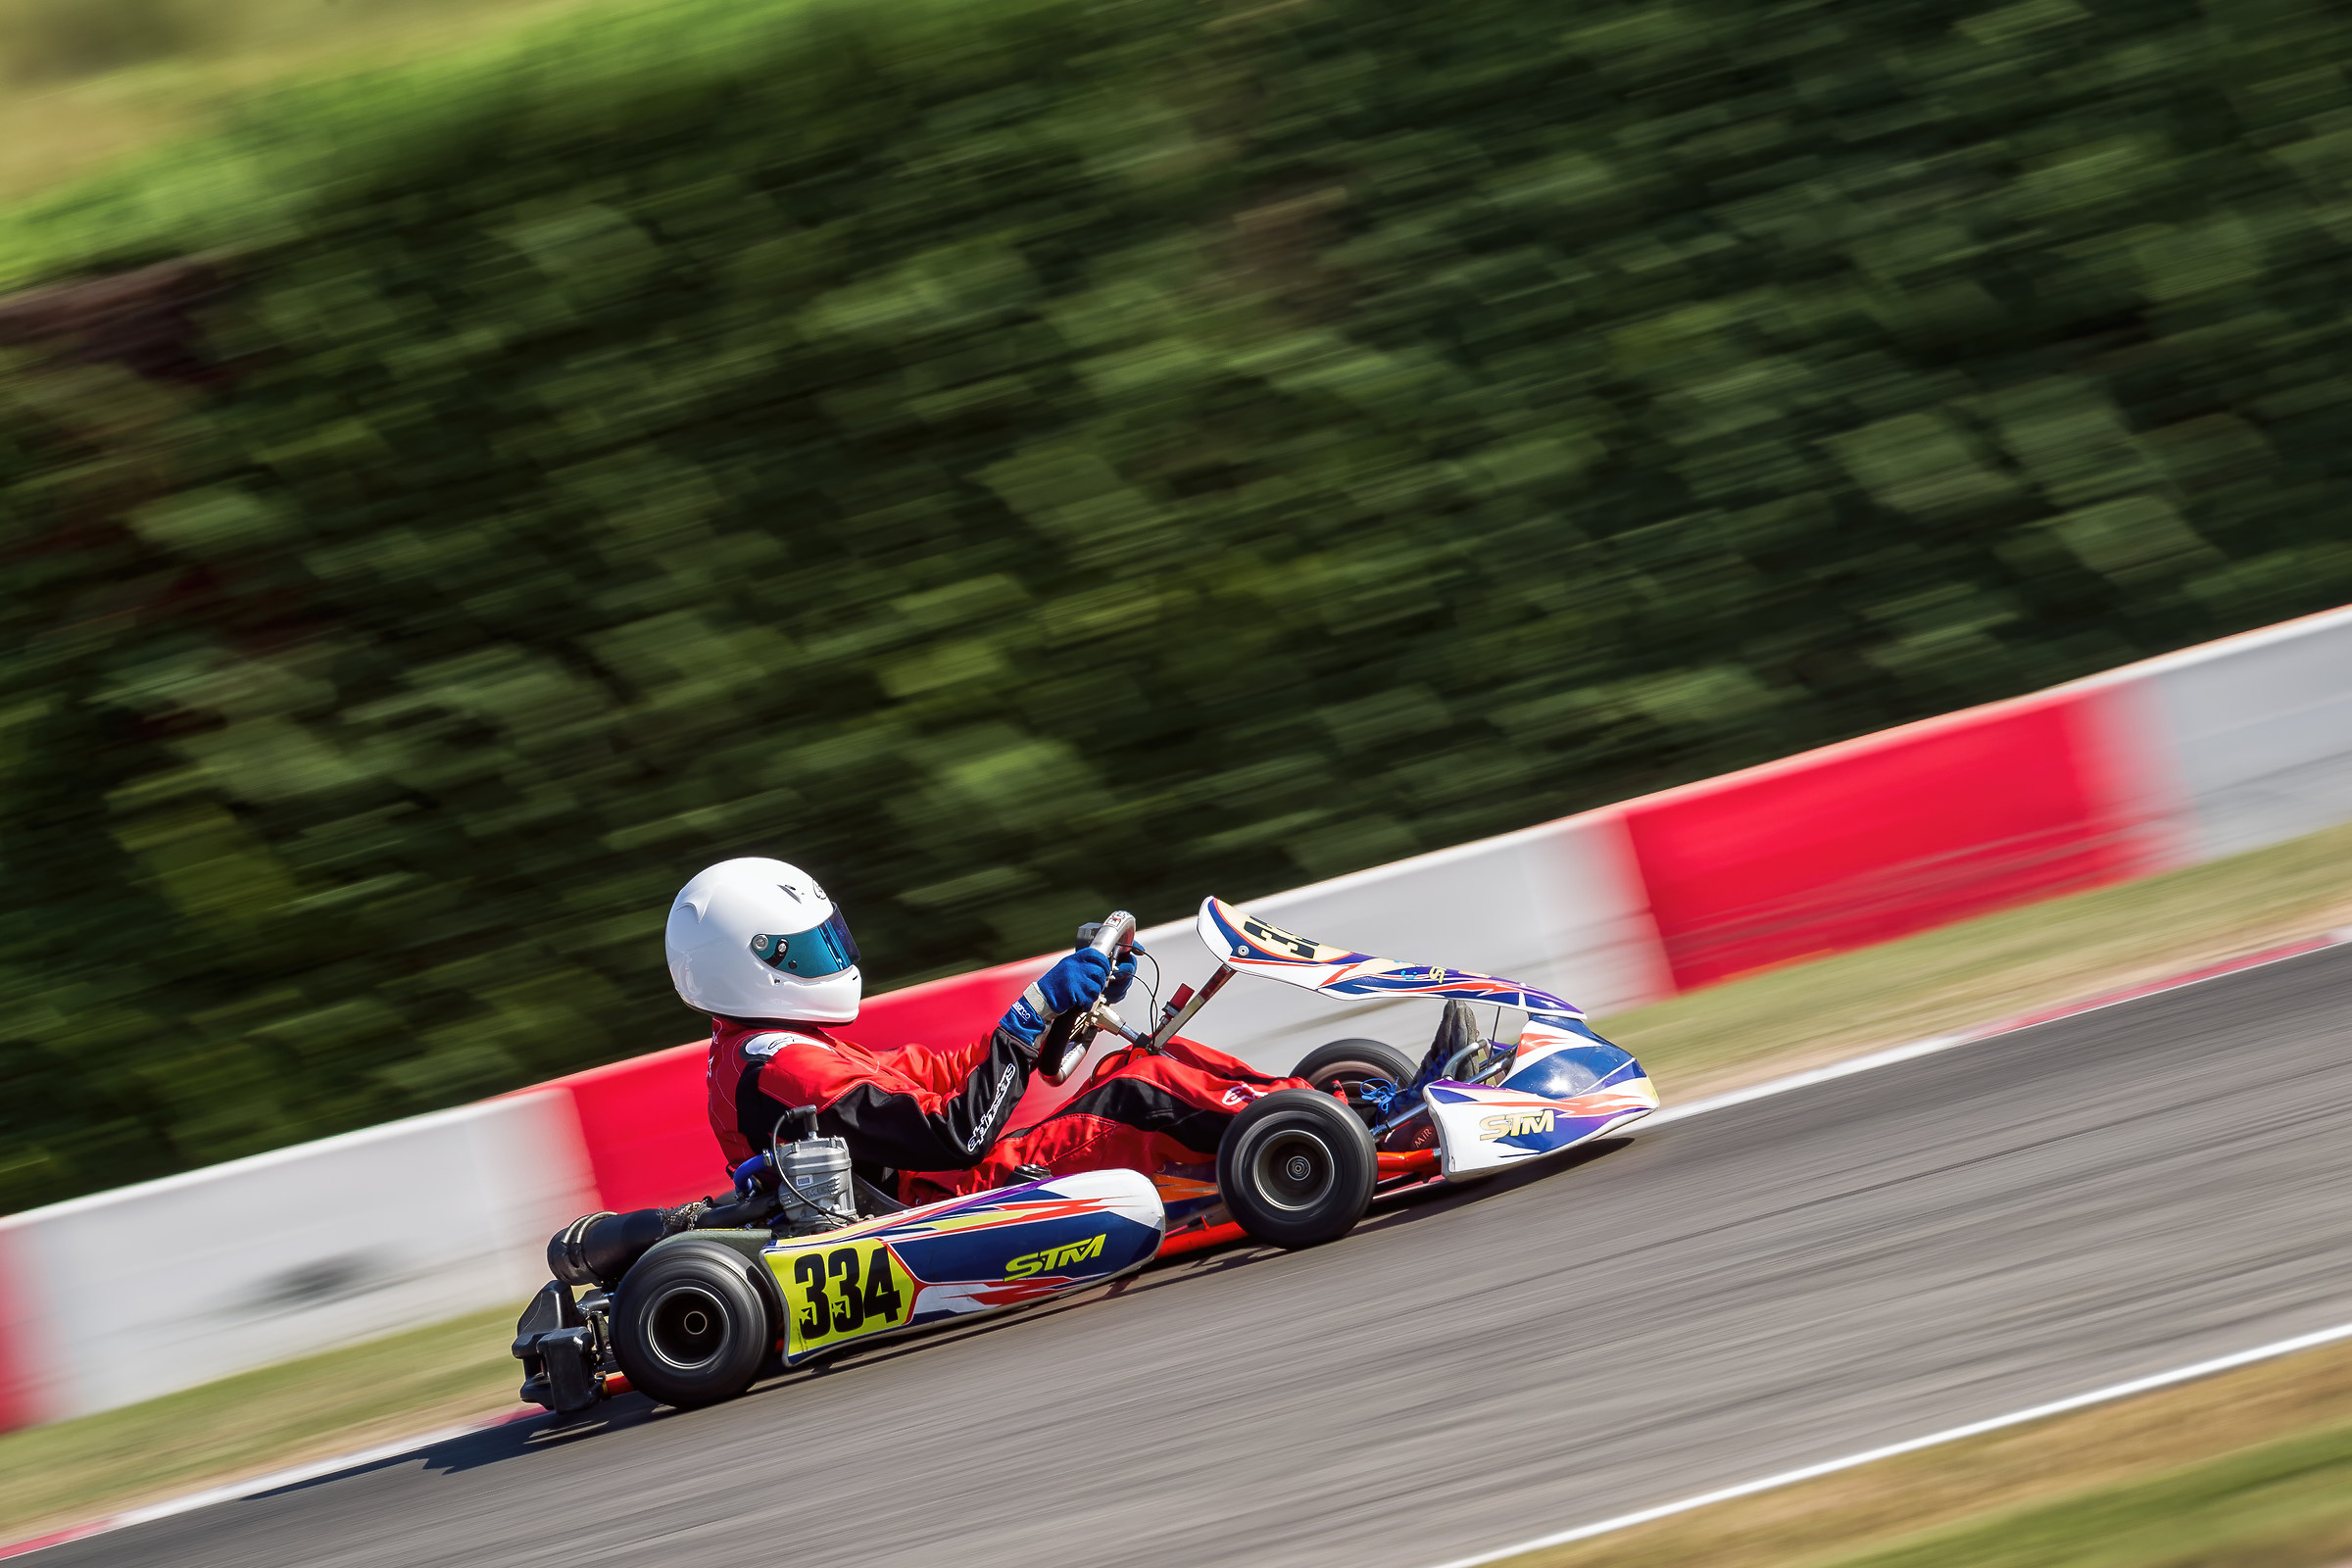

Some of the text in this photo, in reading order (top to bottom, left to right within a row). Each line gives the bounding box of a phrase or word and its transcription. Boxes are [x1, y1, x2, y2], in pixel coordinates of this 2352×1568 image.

[1480, 1109, 1554, 1141] STM
[1004, 1233, 1106, 1283] STM
[794, 1247, 903, 1340] 334
